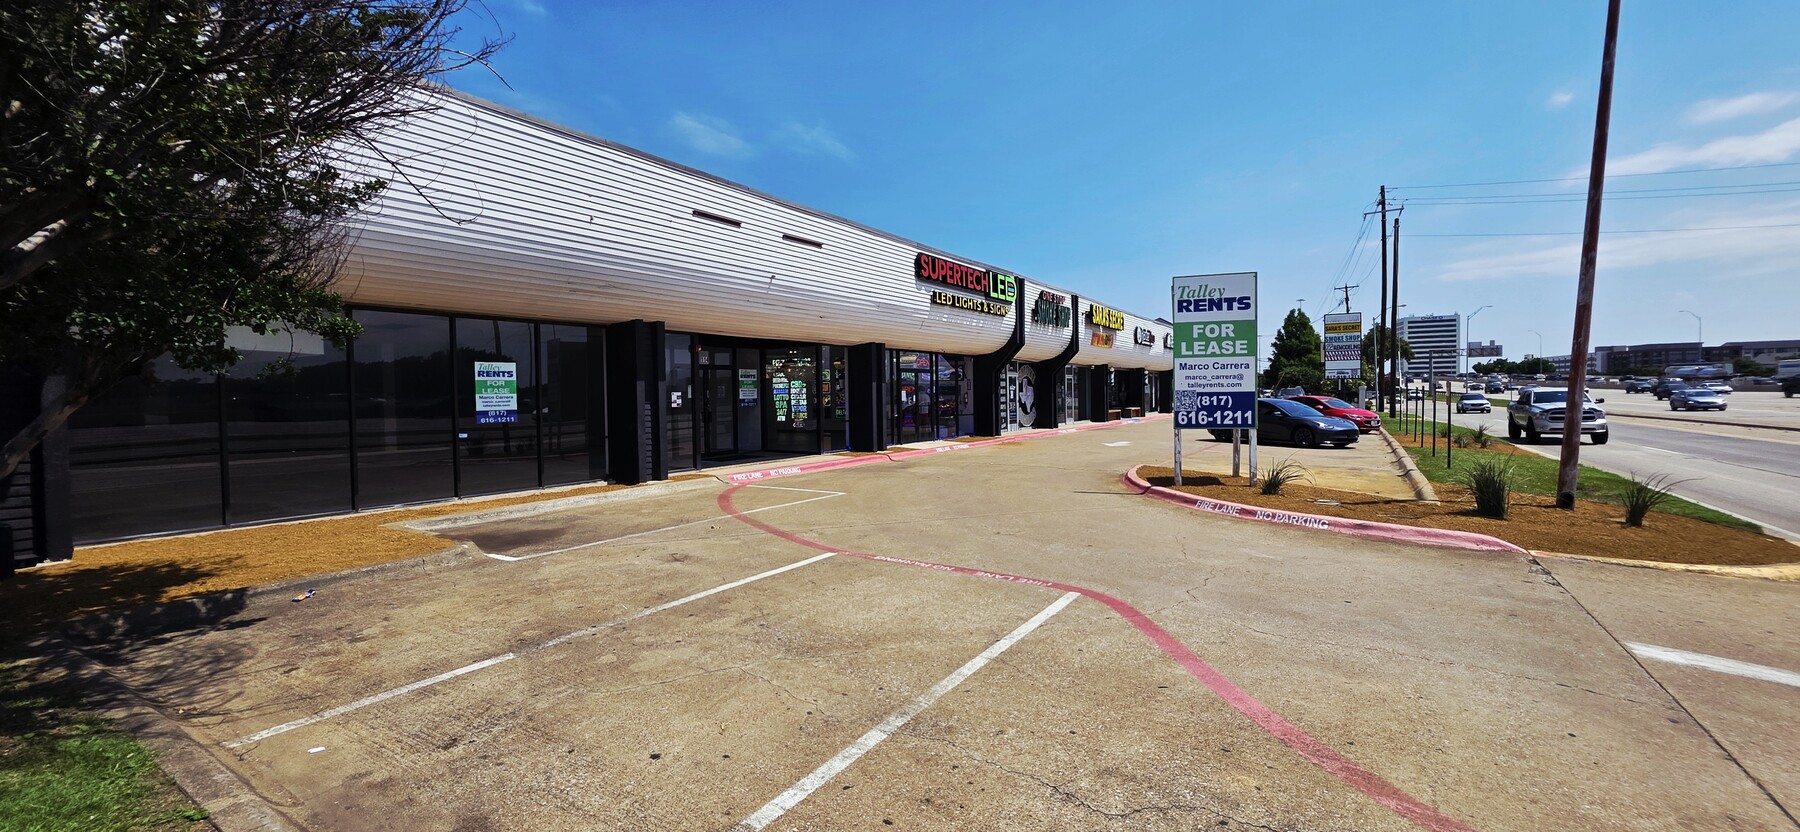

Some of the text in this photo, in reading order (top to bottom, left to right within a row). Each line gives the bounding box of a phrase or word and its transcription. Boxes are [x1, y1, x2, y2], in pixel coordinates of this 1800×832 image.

[920, 254, 1018, 302] SUPERTECH LED
[1043, 291, 1053, 302] ONE
[1178, 284, 1226, 302] Talley
[936, 291, 1009, 316] LED LIGHTS & SIGNS
[1177, 296, 1252, 313] RENTS
[1193, 323, 1235, 338] FOR
[1181, 340, 1248, 355] LEASE
[478, 364, 502, 372] Talley
[1179, 362, 1250, 371] Marco Carrera
[1185, 373, 1244, 381] marco_carrera@
[775, 401, 788, 409] SPA
[1197, 395, 1233, 408] (817)
[1178, 410, 1253, 425] 616-1211
[732, 466, 801, 481] FIRE LANE NO PARKING
[1195, 500, 1330, 530] FIRE LANE NO PARKING
[874, 555, 932, 568] PARKING
[933, 564, 956, 572] NO
[973, 571, 1014, 582] LANE
